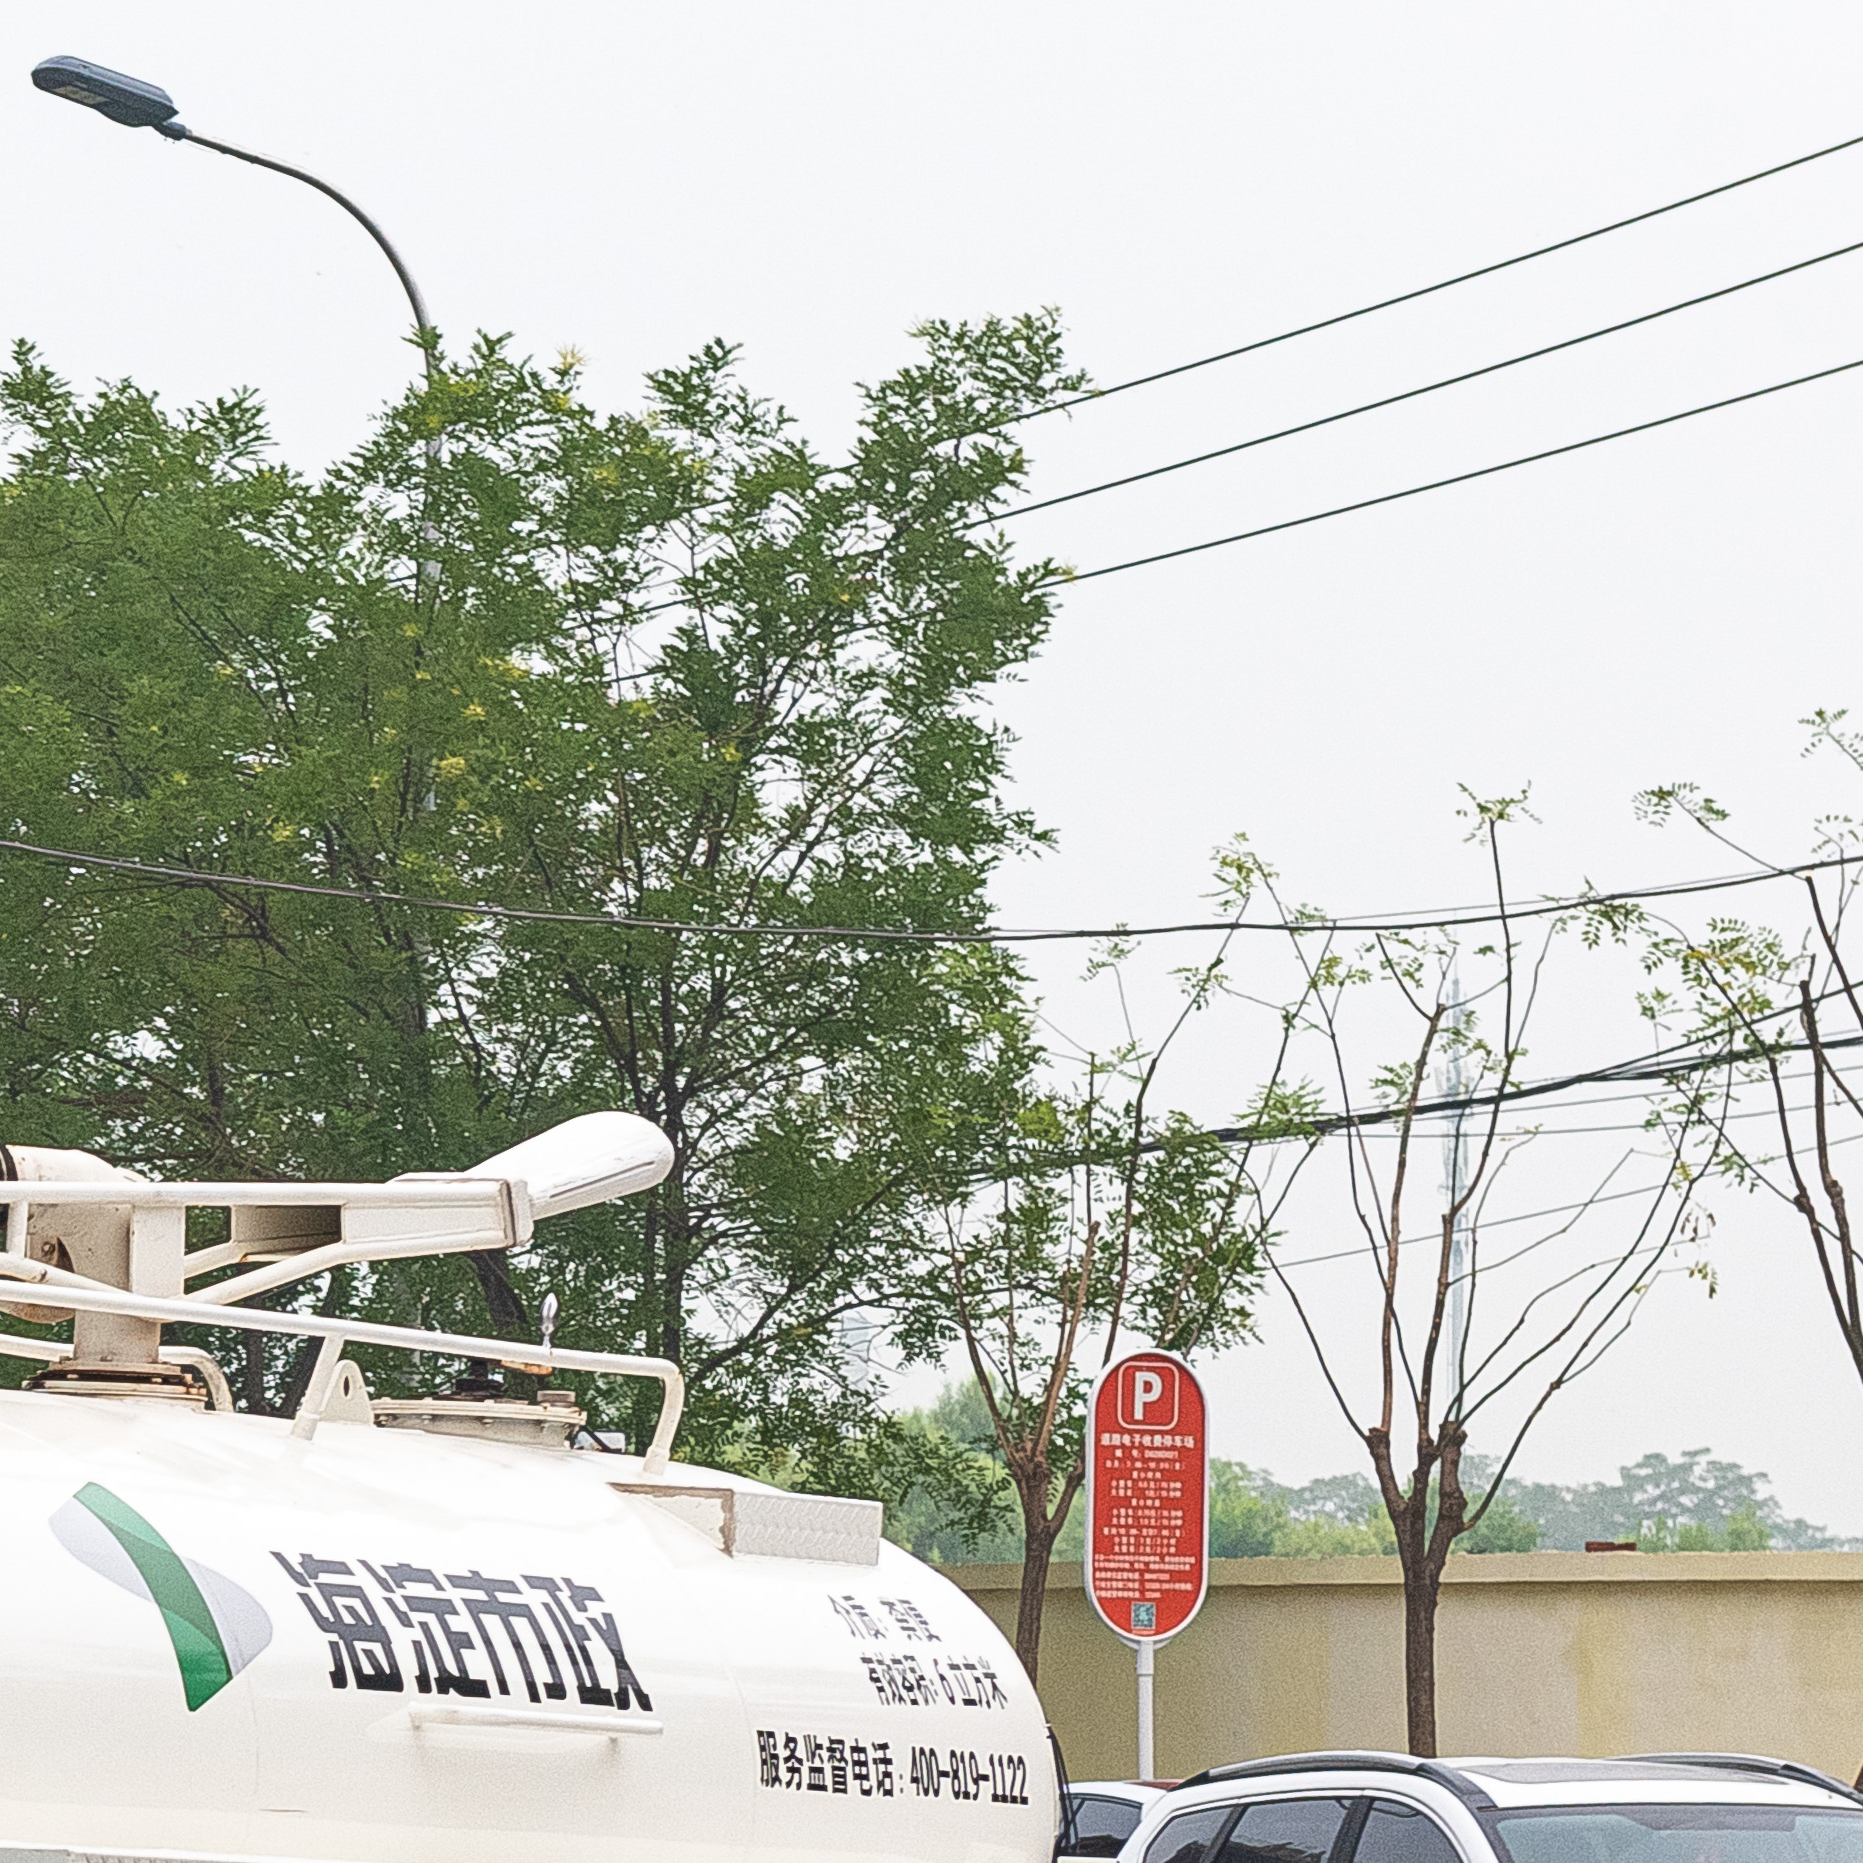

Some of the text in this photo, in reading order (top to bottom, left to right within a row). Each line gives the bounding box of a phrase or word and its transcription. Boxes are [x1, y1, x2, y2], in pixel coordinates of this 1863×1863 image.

[1134, 1371, 1163, 1420] P
[268, 1550, 654, 1713] 海淀市政
